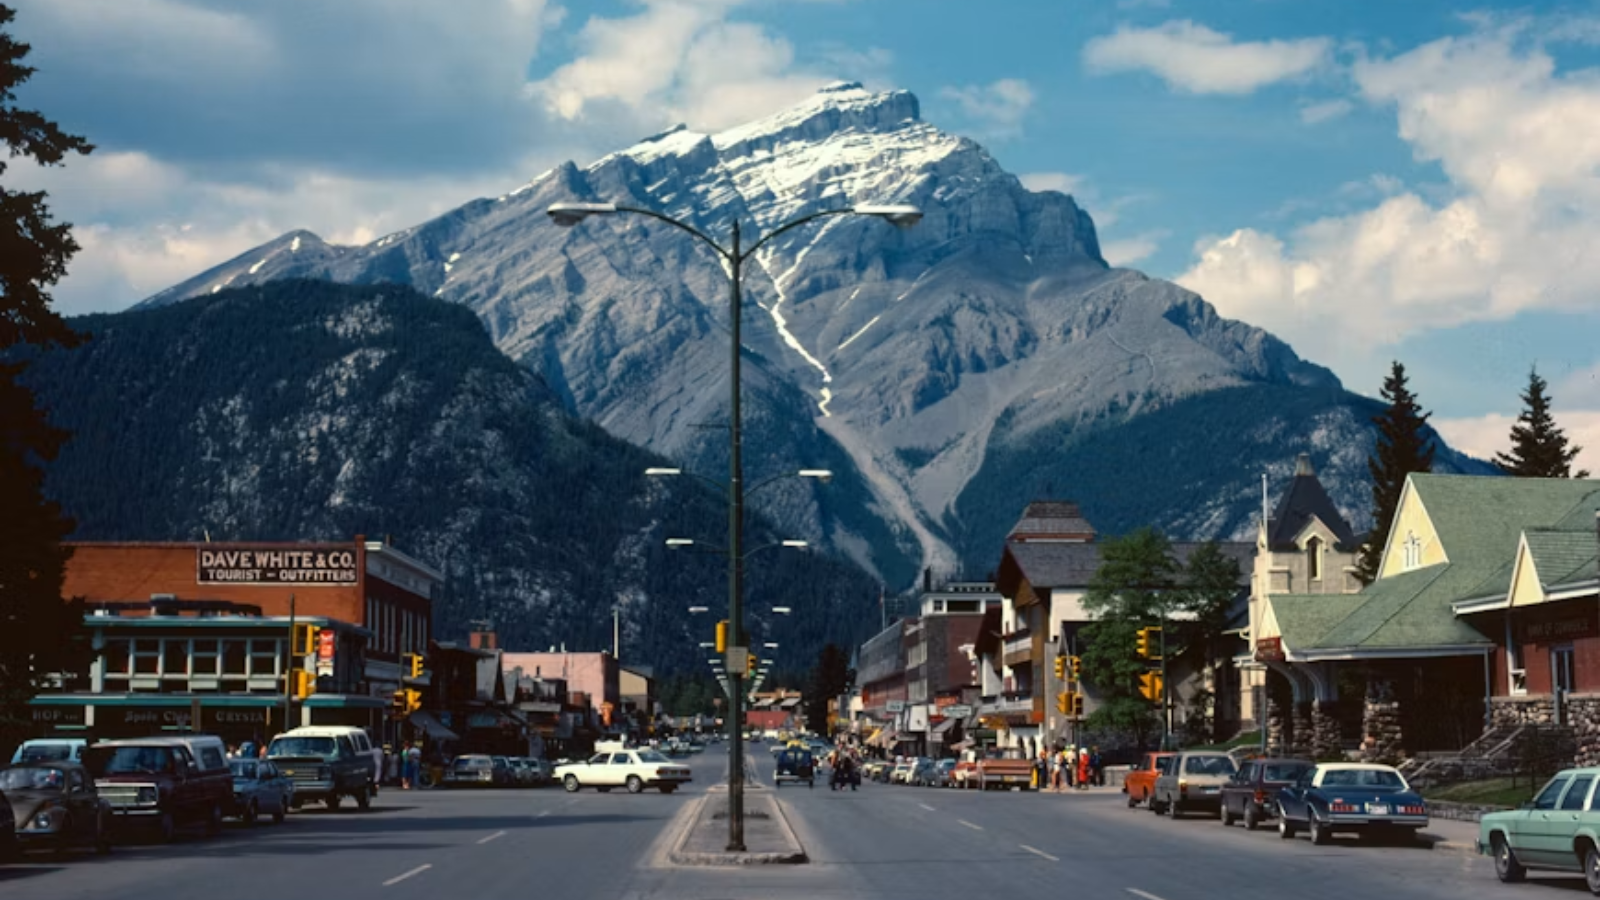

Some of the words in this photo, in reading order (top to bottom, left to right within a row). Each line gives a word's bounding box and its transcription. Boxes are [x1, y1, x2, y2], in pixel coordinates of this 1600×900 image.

[202, 551, 252, 568] DAVE
[255, 552, 313, 568] WHITE
[315, 553, 326, 568] &
[328, 552, 356, 568] CO.
[207, 569, 261, 581] TOURIST
[279, 569, 356, 581] OUTFITTERS
[215, 711, 265, 722] CRYSTA
